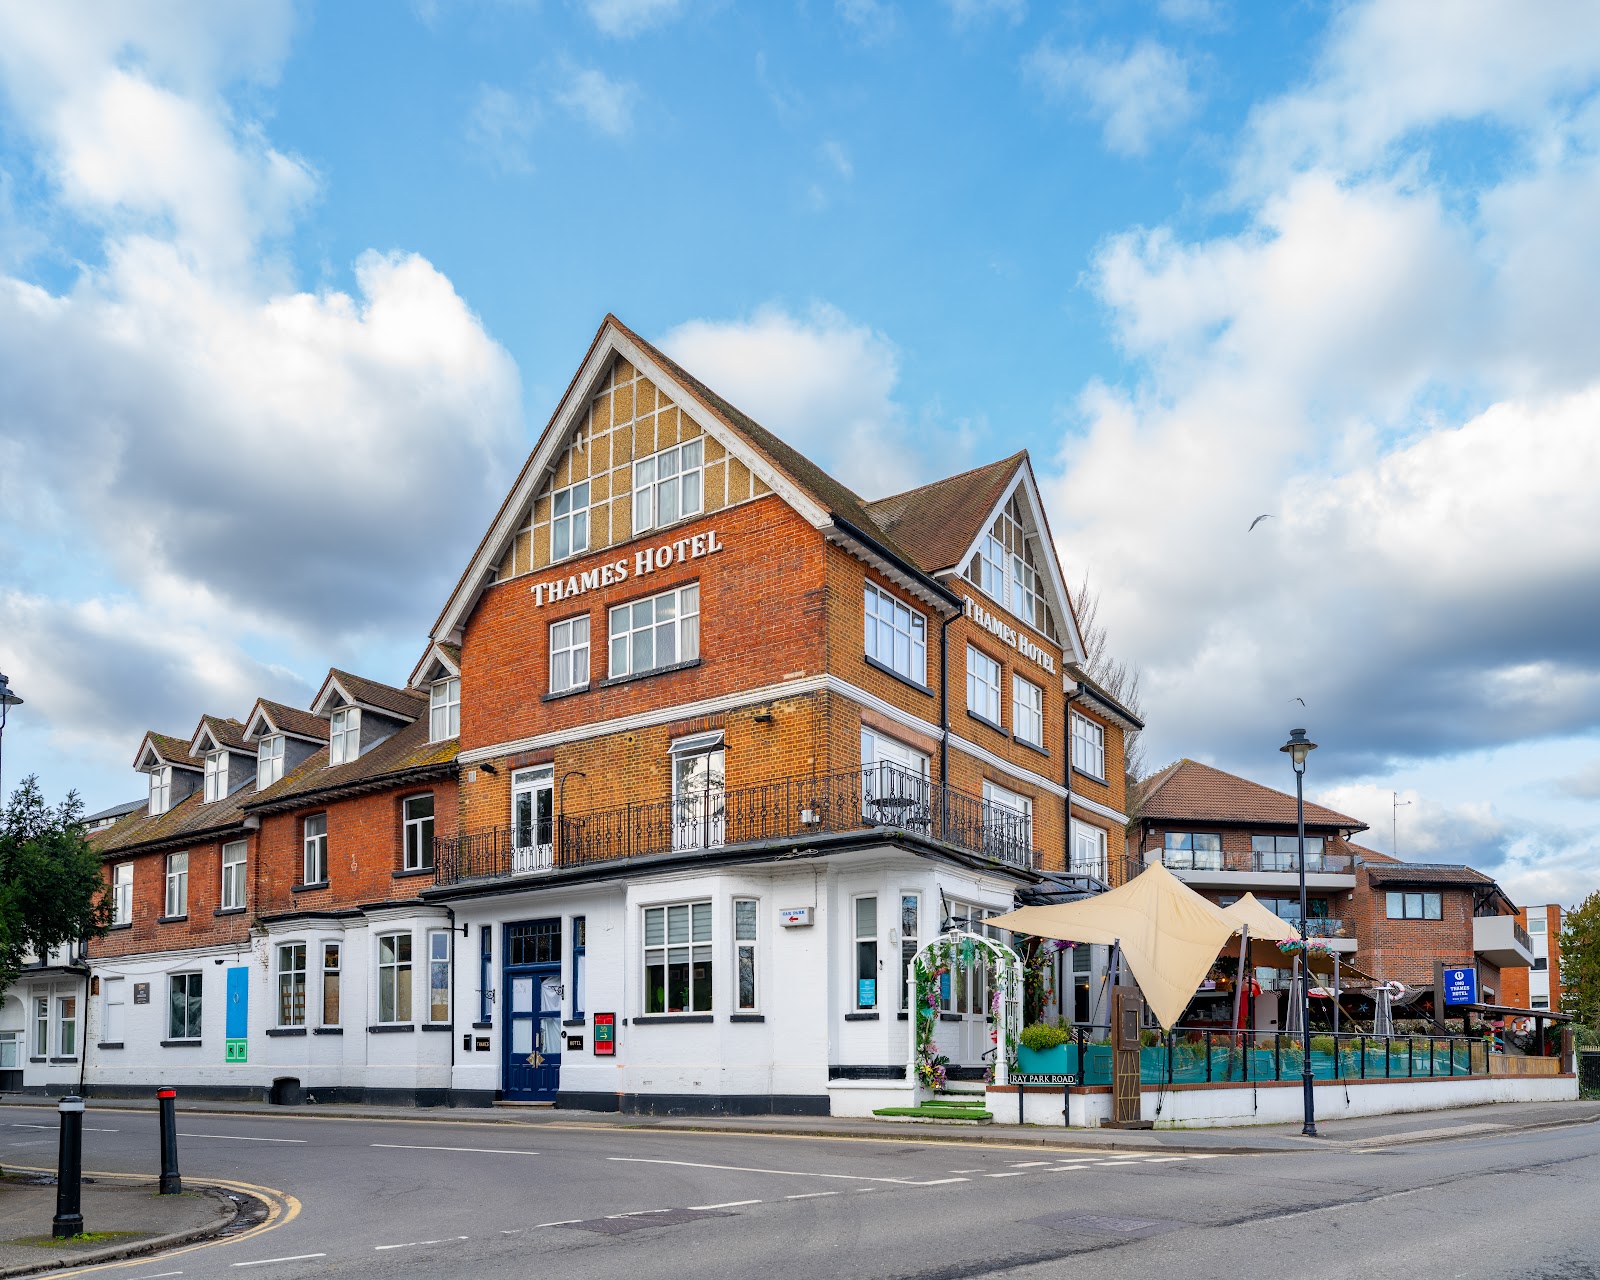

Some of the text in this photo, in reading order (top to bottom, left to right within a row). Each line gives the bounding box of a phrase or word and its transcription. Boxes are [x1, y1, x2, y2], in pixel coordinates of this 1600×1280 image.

[530, 530, 723, 607] THAMES HOTEL
[963, 594, 1056, 675] THAMES HOTEL
[1012, 1075, 1074, 1083] RAY PARK ROAD
